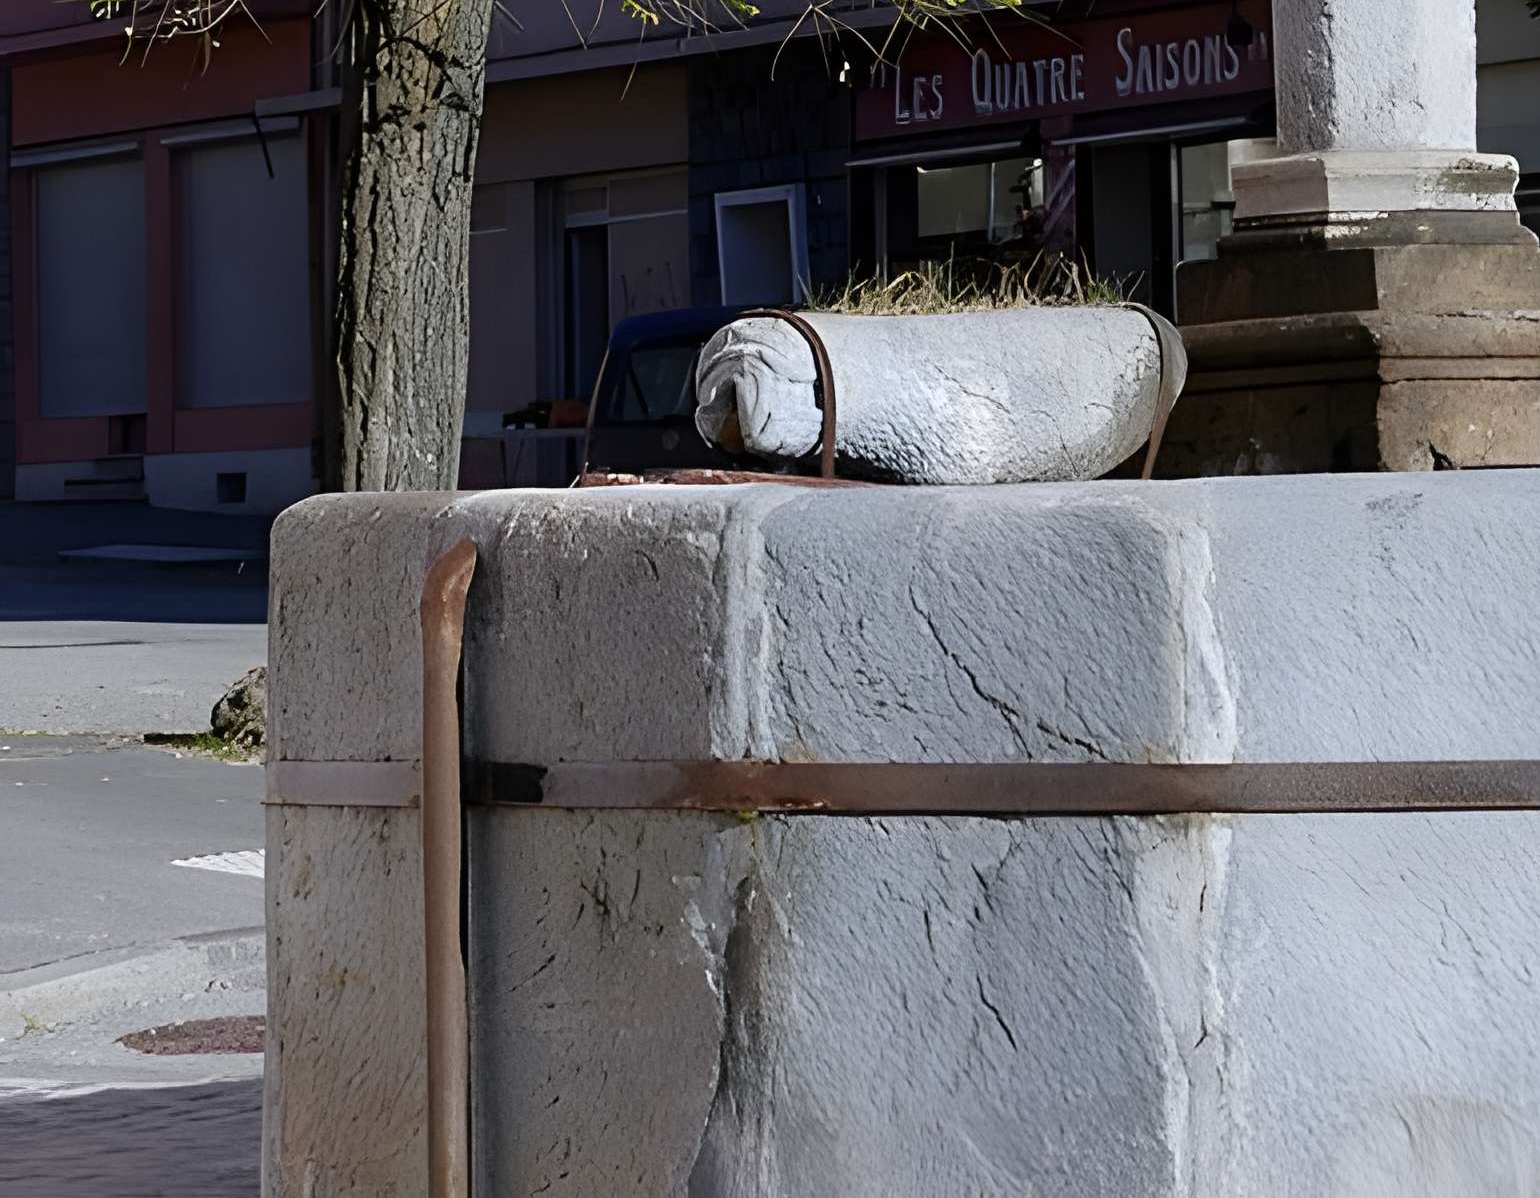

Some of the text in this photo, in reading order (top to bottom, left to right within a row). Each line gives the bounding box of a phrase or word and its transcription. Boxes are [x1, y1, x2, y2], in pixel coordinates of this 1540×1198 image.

[896, 65, 944, 124] LES
[972, 48, 1085, 114] QUATRE
[1115, 27, 1240, 96] SAISONS
